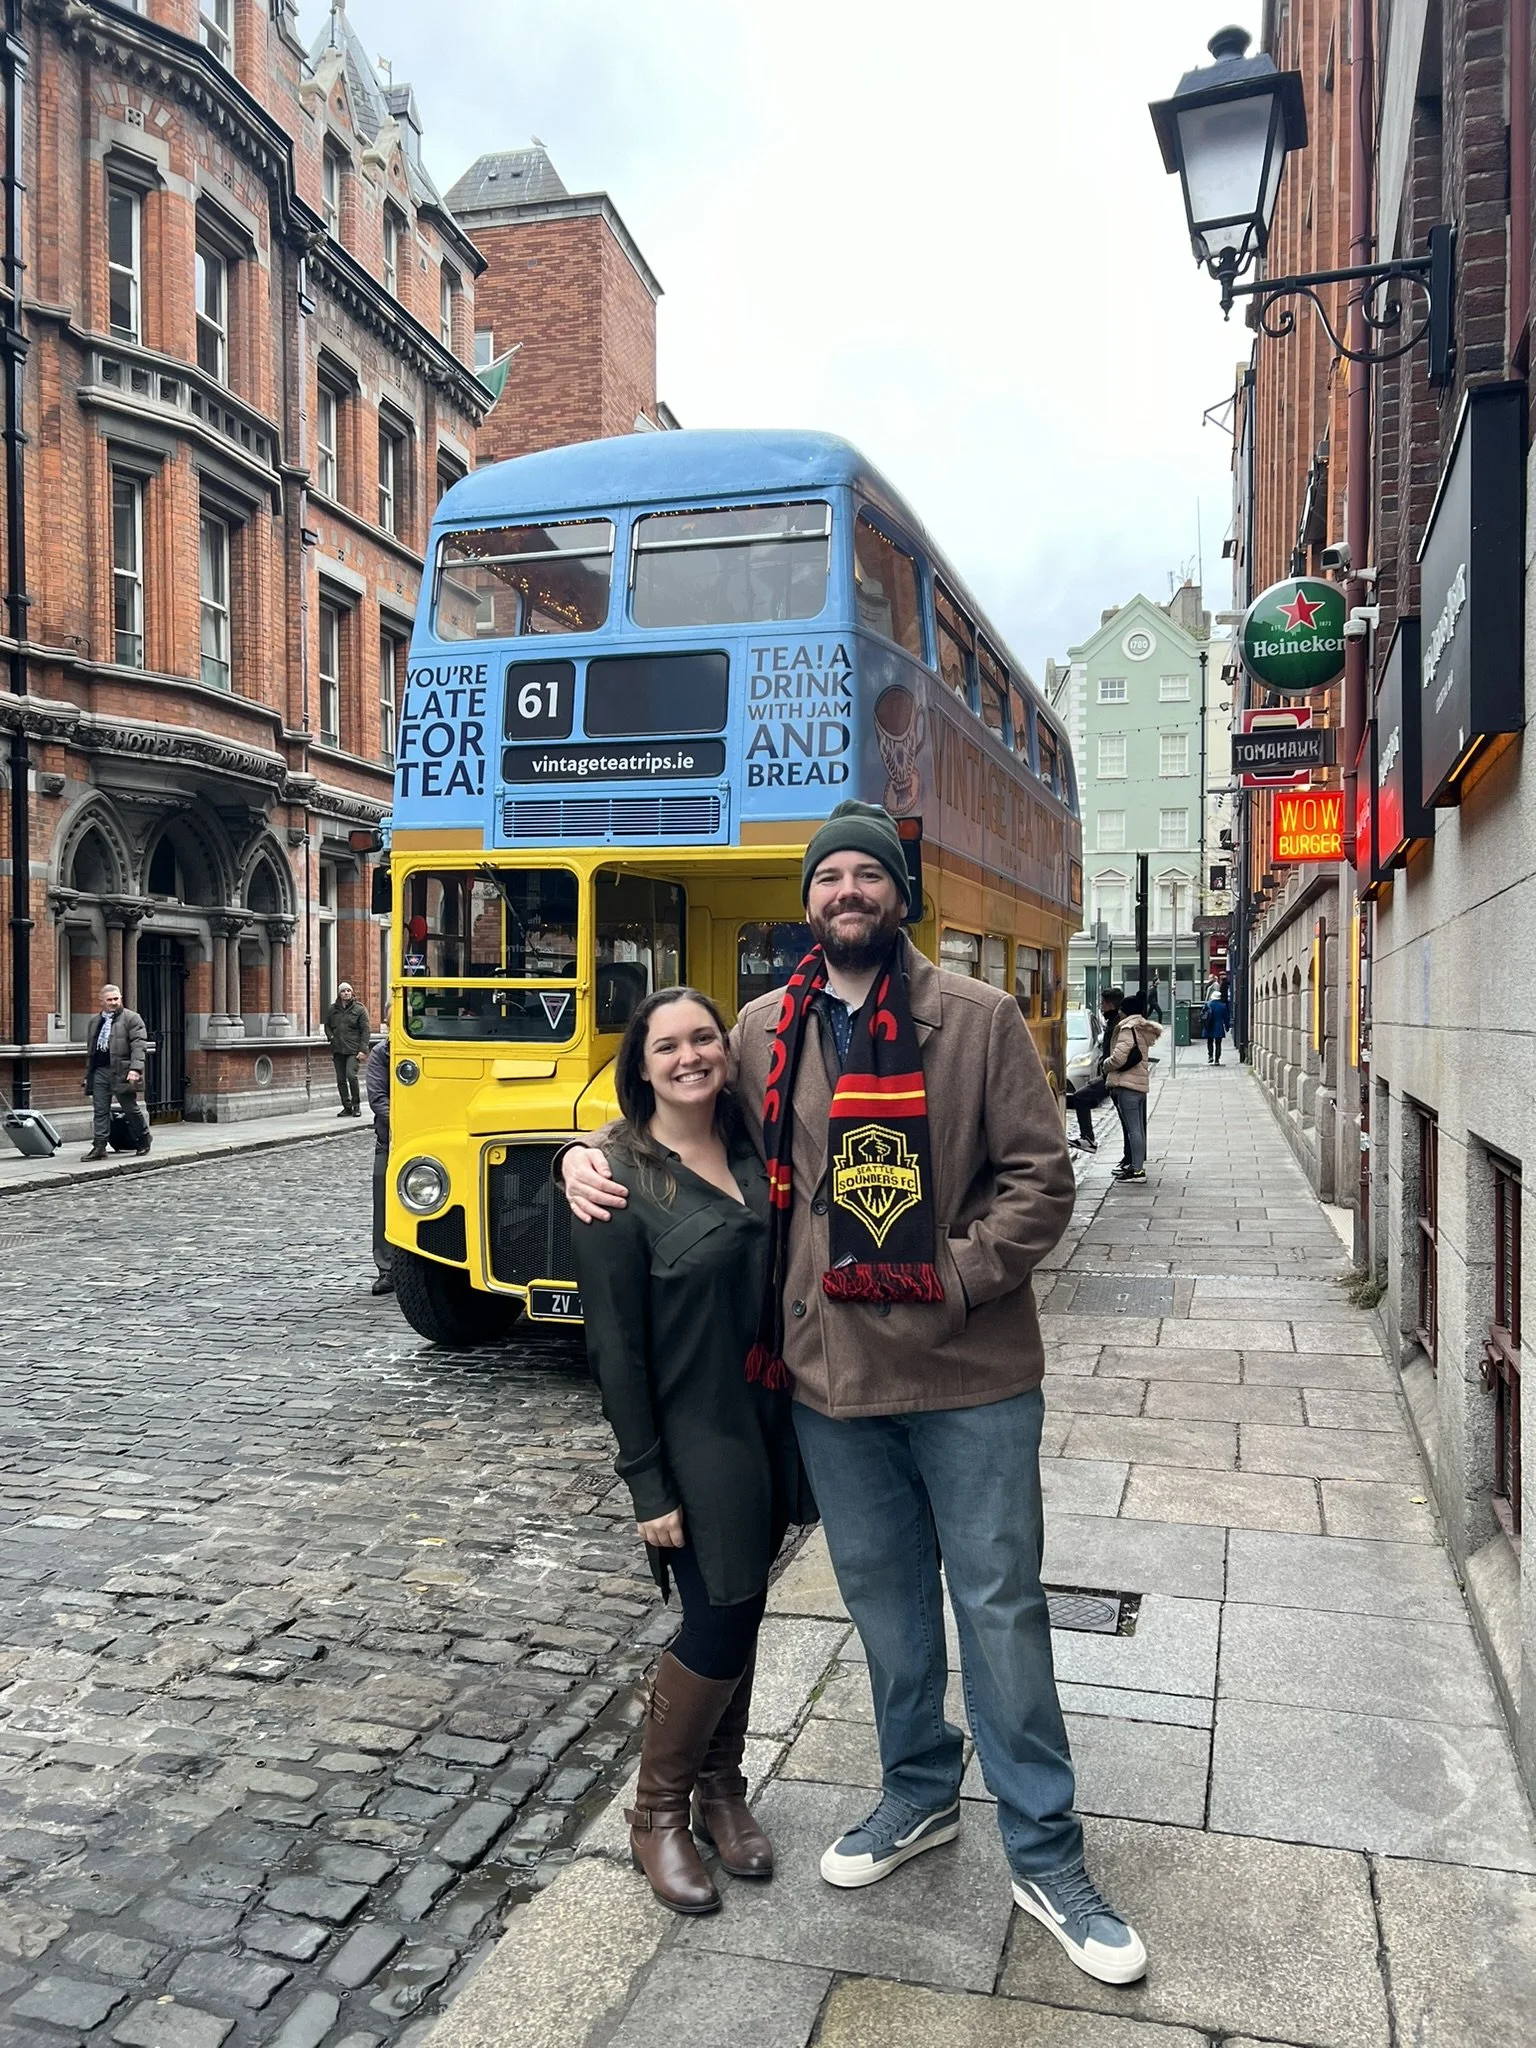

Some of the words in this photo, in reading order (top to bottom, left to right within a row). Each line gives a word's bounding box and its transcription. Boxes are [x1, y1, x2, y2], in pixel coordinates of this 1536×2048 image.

[751, 644, 824, 672] TEA!
[828, 643, 853, 669] A
[1253, 635, 1345, 658] Heineken
[407, 664, 488, 689] YOU'RE
[750, 672, 854, 700] DRINK
[402, 688, 487, 721] LATE
[517, 681, 559, 719] 61
[747, 702, 803, 720] WITH
[806, 701, 851, 718] JAM
[400, 721, 485, 759] FOR
[745, 721, 851, 759] AND
[1235, 740, 1319, 762] TOMAHAWK
[532, 751, 695, 775] vintageteatrips.ie
[748, 761, 850, 787] BREAD
[396, 760, 486, 797] TEA!
[1279, 798, 1341, 832] WOW
[1279, 833, 1342, 856] BURGER
[839, 1174, 899, 1190] SOUNDERS
[900, 1176, 915, 1189] FC
[856, 1165, 895, 1175] SEATTLE
[551, 1294, 571, 1314] ZV
